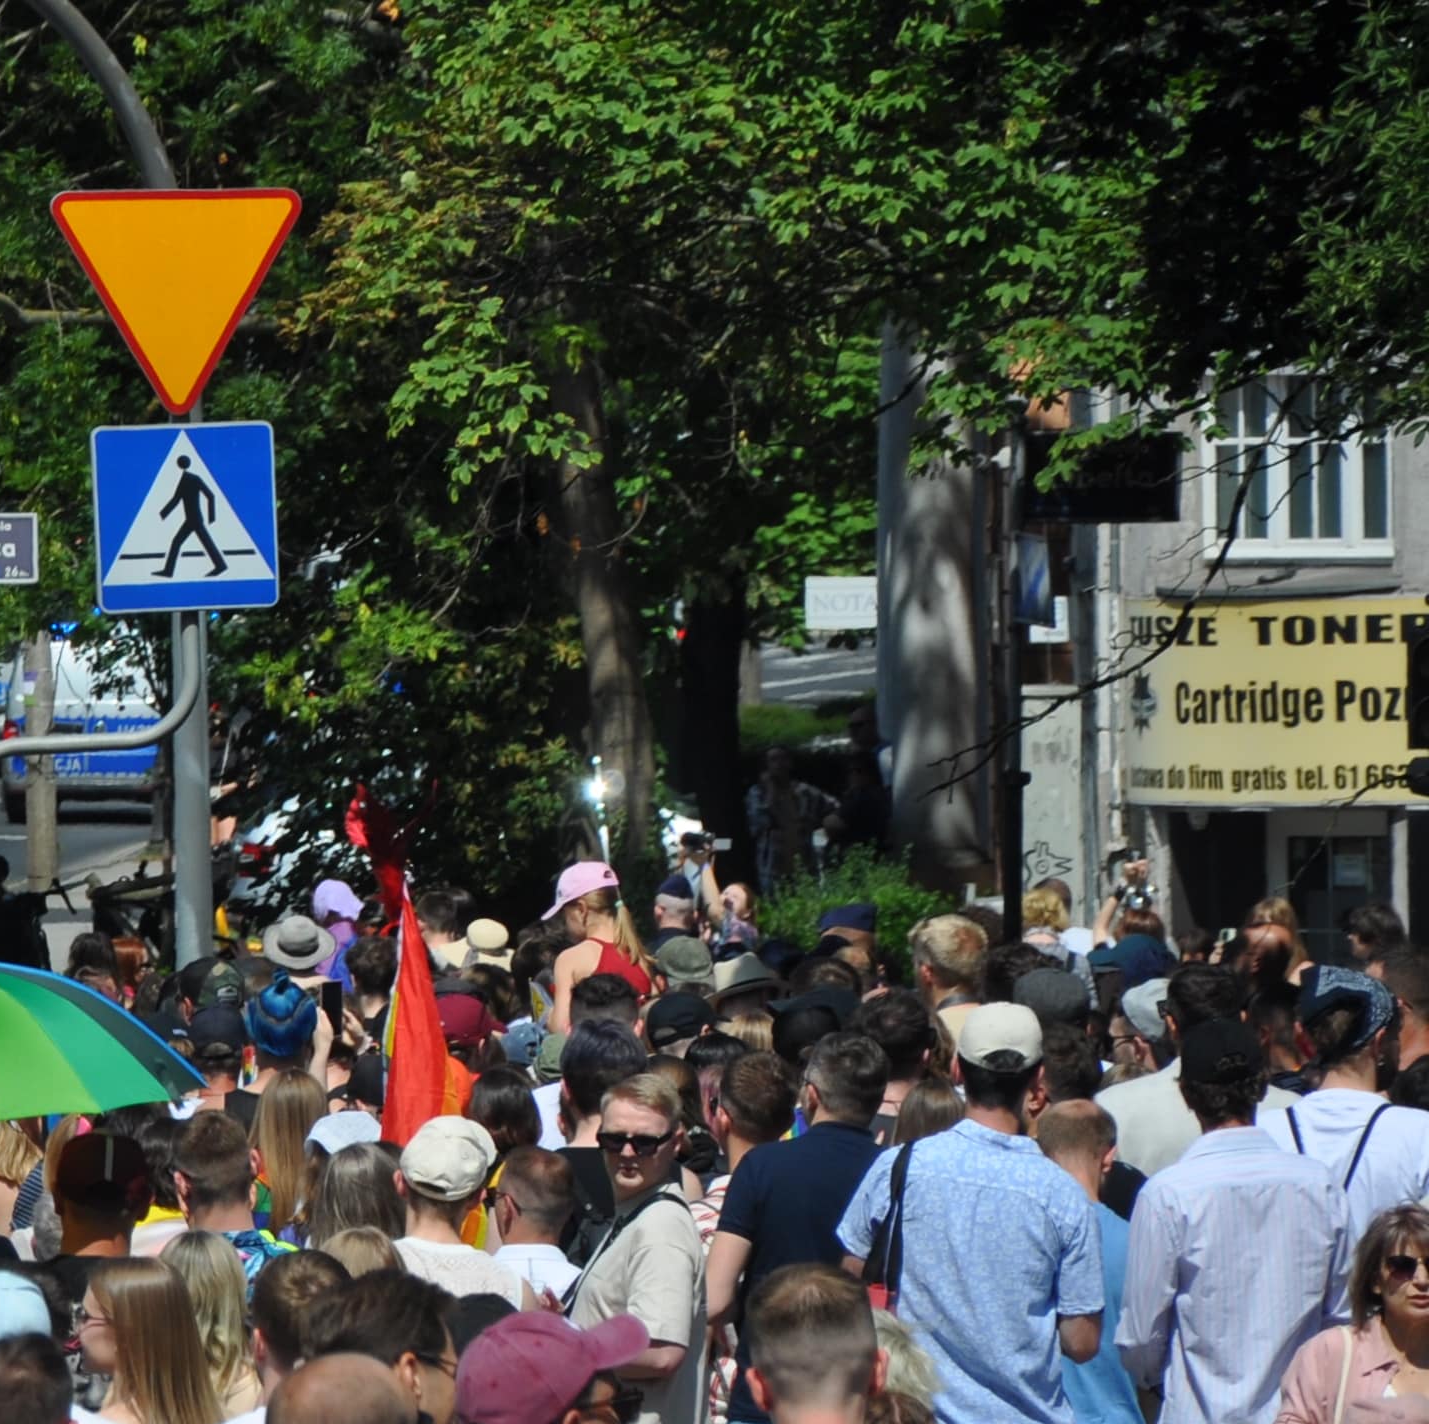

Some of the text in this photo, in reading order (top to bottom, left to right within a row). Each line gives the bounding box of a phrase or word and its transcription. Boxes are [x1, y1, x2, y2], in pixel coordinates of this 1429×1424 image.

[1175, 680, 1324, 728] Cartridge
[1188, 764, 1224, 790] firm
[1231, 765, 1287, 793] gratis
[1296, 766, 1329, 790] tel.
[1334, 764, 1358, 790] 61
